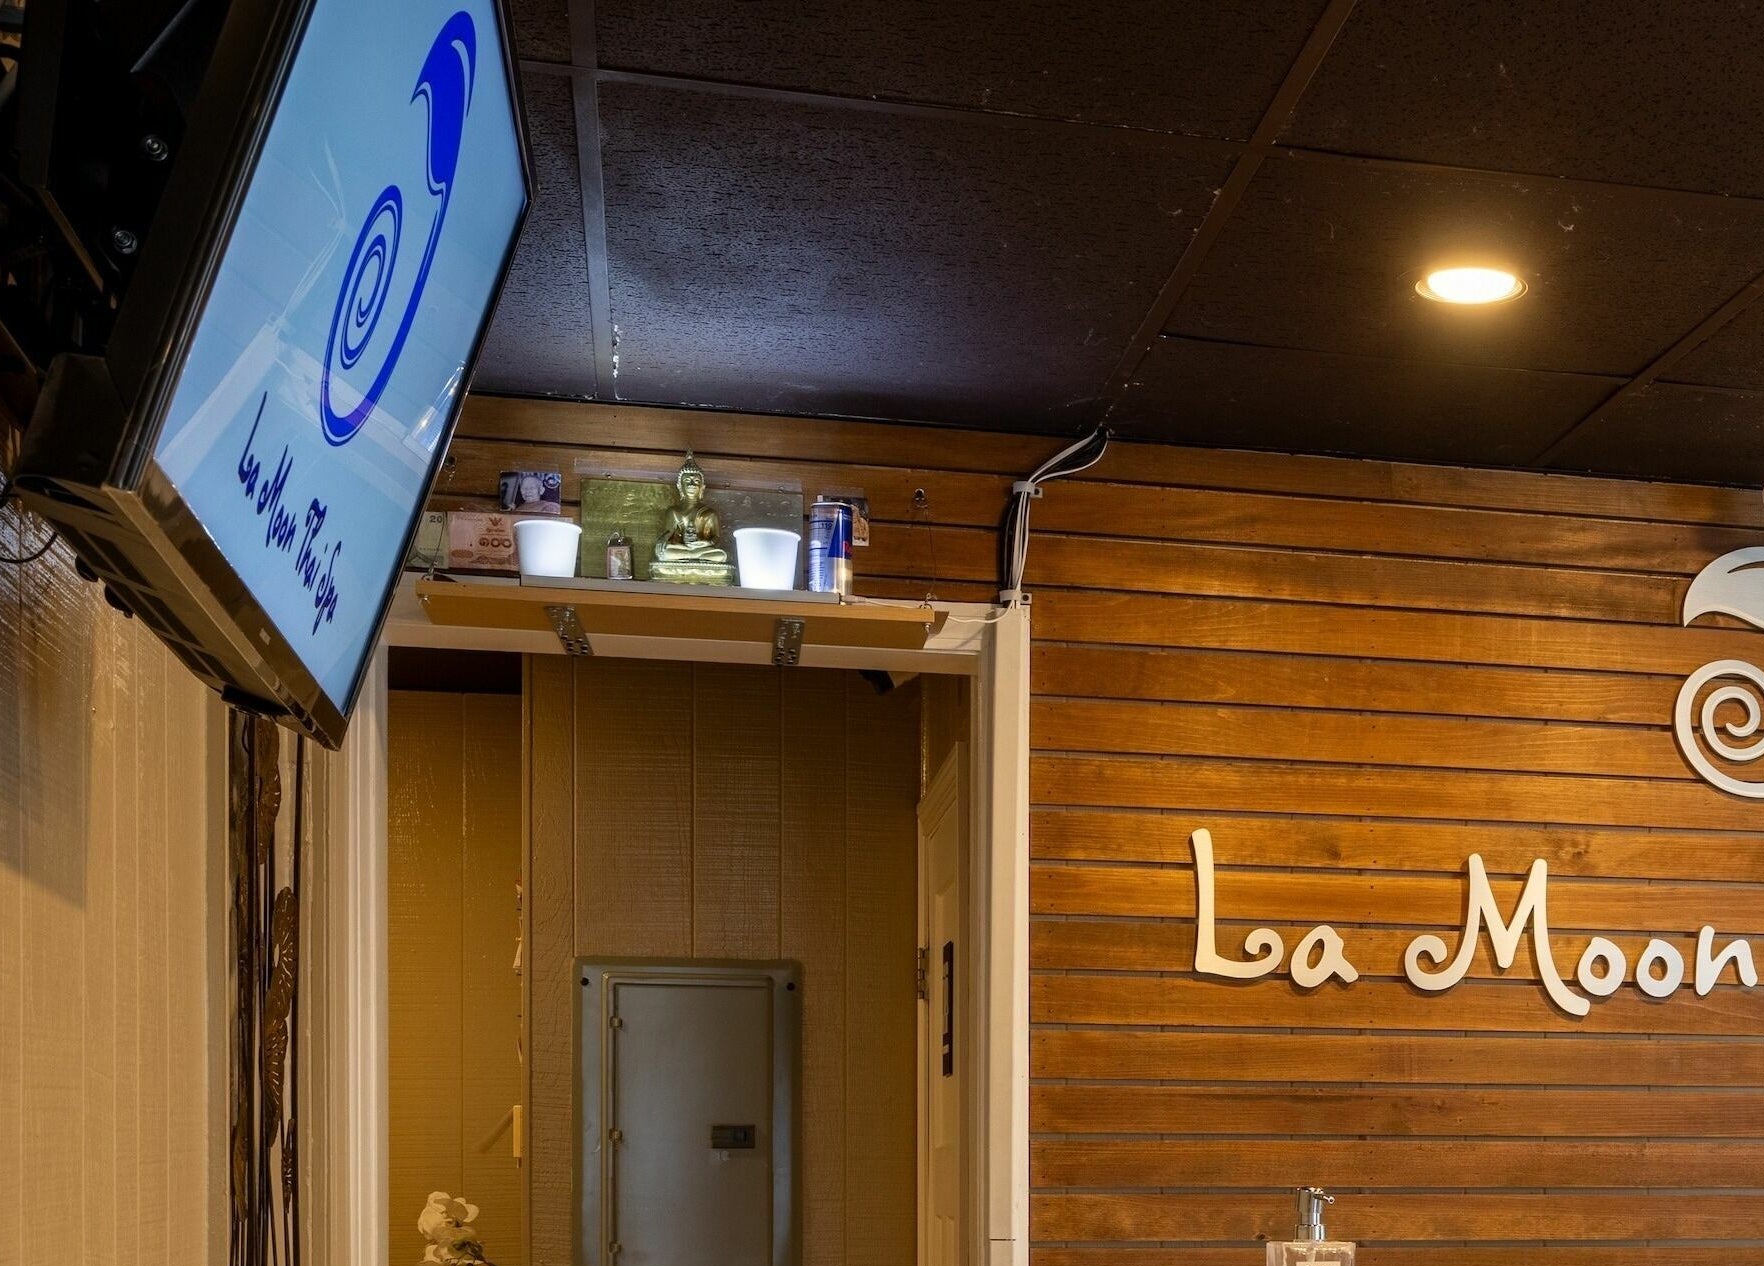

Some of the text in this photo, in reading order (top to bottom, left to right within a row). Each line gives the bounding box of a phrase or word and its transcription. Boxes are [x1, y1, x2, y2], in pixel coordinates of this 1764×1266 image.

[238, 391, 342, 636] La Moon Thai Spa
[429, 515, 443, 523] 20
[1191, 827, 1360, 991] La
[1403, 852, 1759, 1017] Moon
